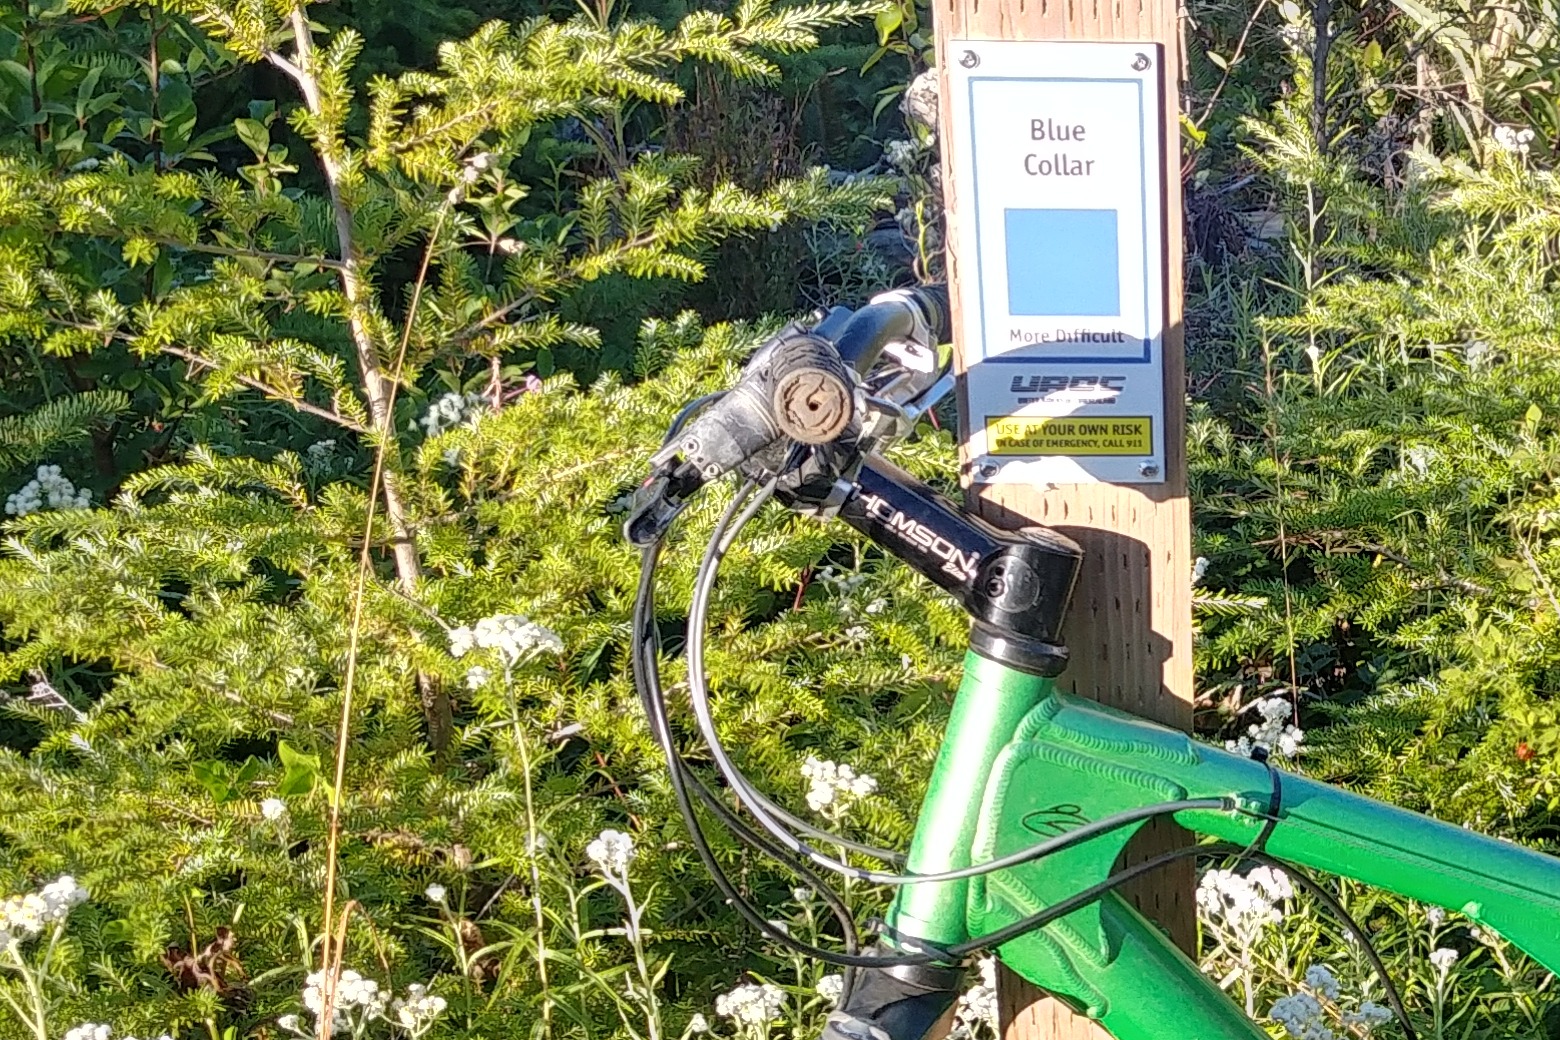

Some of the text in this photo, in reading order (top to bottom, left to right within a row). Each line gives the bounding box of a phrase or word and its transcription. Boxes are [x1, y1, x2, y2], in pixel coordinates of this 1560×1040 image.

[1030, 117, 1086, 141] Blue
[1024, 153, 1095, 176] Collar
[1010, 329, 1126, 343] More Difficult
[996, 424, 1143, 436] USE AT YOUR OWN RISK
[1008, 439, 1031, 448] CASE
[1032, 439, 1045, 448] OF
[1046, 439, 1101, 449] EMERGENCY,
[1102, 439, 1125, 448] CALL
[1126, 439, 1143, 449] 911
[851, 484, 980, 579] HOMSON
